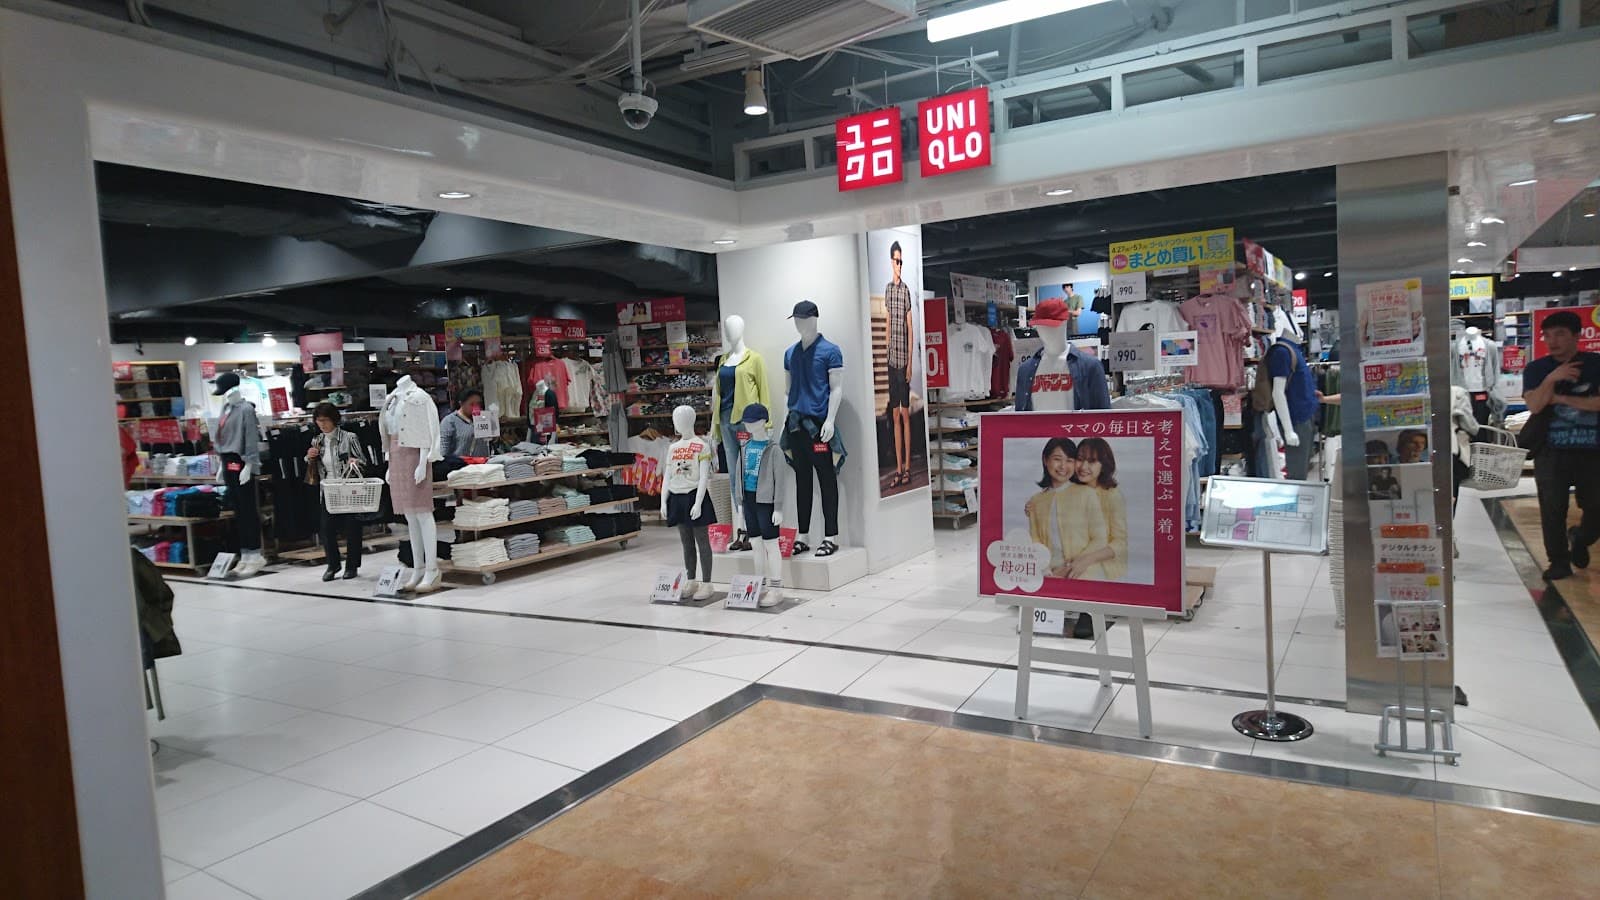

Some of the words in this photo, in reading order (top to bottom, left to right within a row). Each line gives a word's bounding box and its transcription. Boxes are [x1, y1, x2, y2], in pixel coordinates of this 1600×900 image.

[926, 99, 976, 135] UNI
[845, 118, 892, 151] ユニ
[928, 131, 983, 170] QLO
[845, 149, 894, 182] クロ
[1128, 246, 1204, 269] まとめ買い
[1060, 419, 1155, 435] ママの毎日を
[1157, 419, 1175, 542] 考えて選ぶ一着。
[1380, 543, 1437, 552] デジタルチラシ
[999, 560, 1036, 577] 母の日
